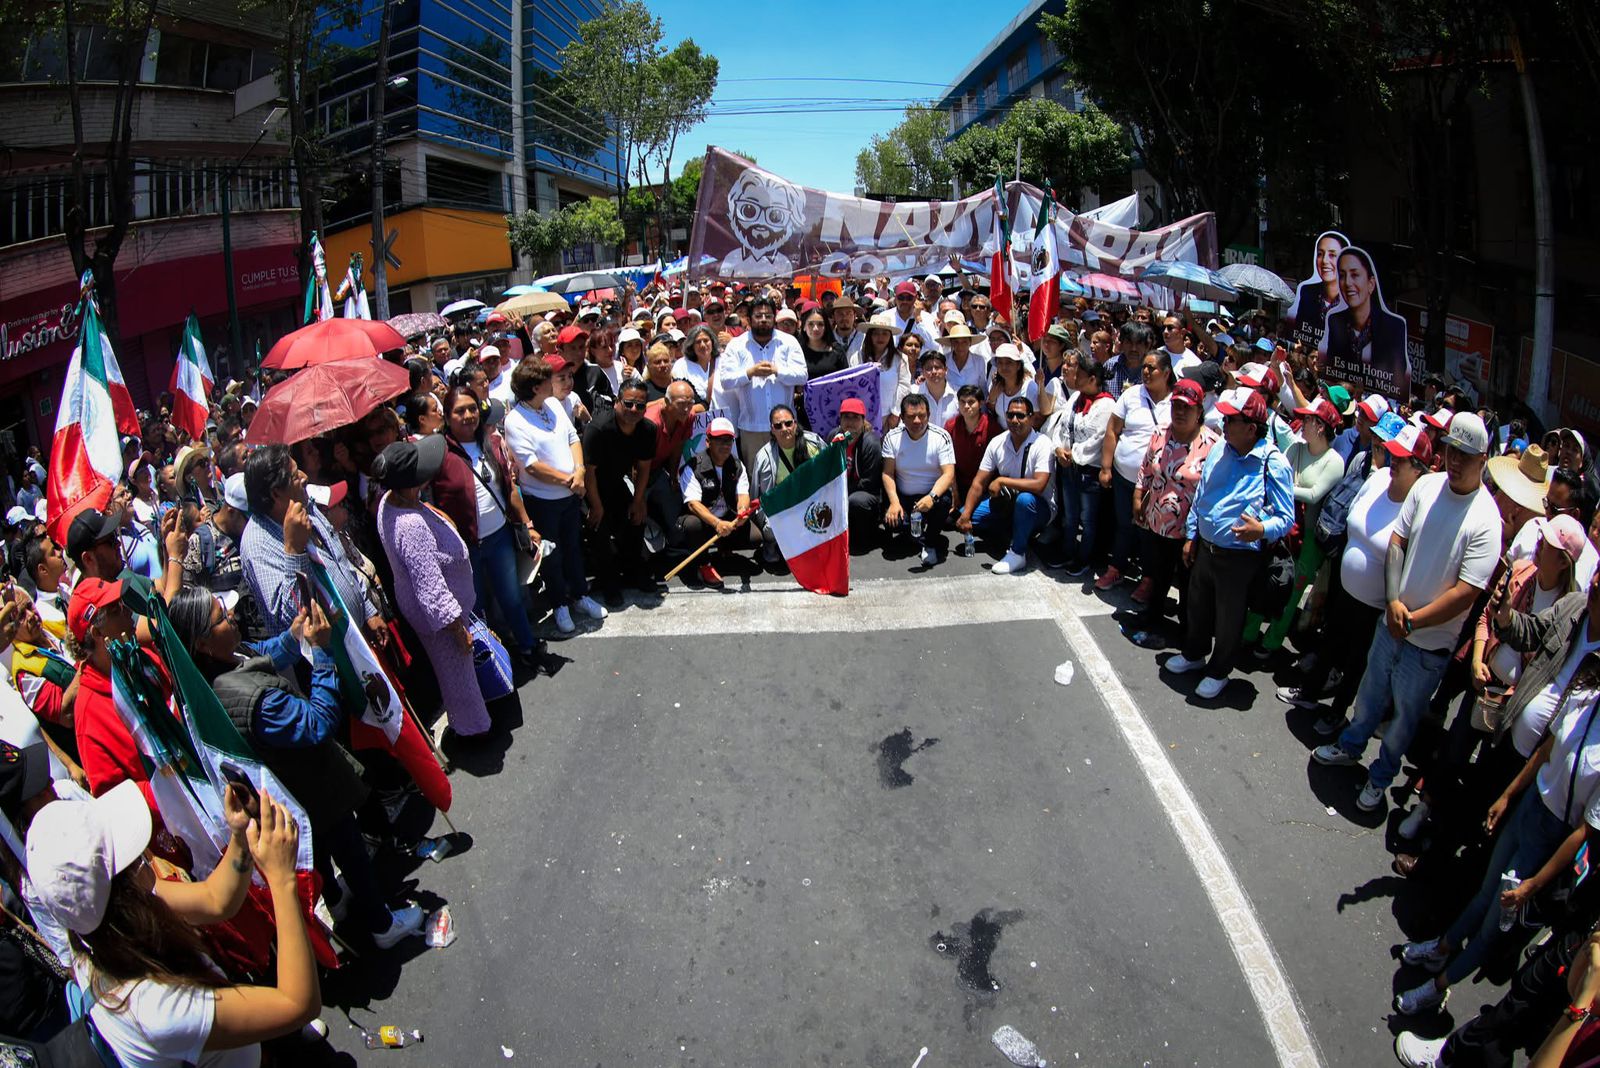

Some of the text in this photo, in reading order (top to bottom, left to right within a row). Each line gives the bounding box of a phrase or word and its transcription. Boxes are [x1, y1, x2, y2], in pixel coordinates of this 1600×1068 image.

[241, 268, 277, 285] CUMPLE
[278, 267, 289, 278] TU
[1293, 329, 1313, 343] Estar
[1301, 321, 1313, 334] Es
[0, 319, 79, 361] lusión
[1334, 356, 1394, 381] Es un Honor
[1325, 366, 1401, 395] Estar con la Mejor.
